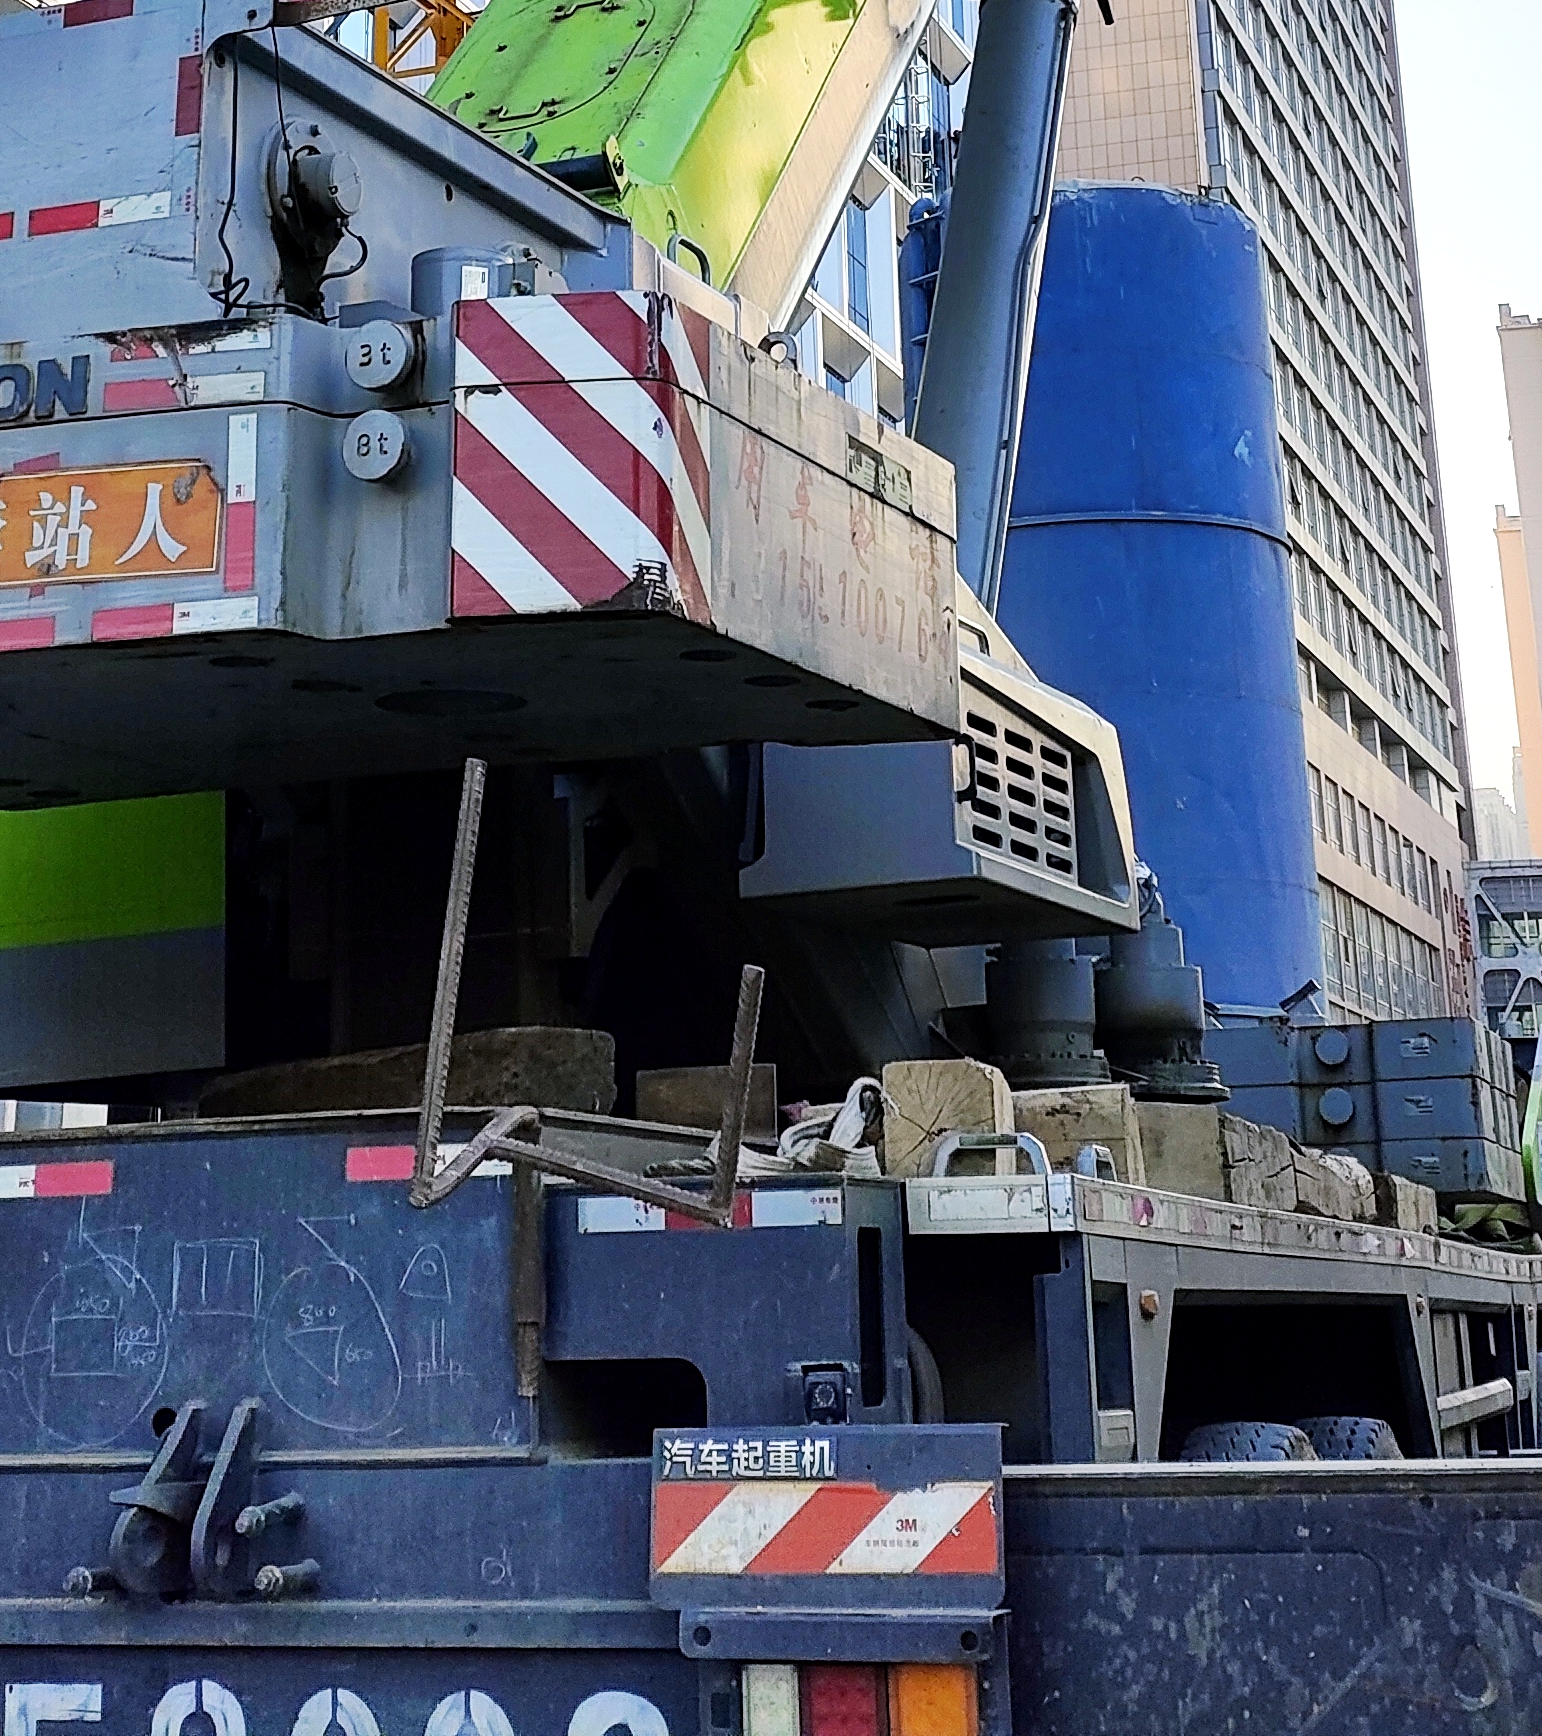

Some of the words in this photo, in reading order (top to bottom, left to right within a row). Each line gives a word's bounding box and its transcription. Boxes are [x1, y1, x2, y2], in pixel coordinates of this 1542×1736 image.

[662, 1438, 835, 1478] 汽车起重机
[895, 1518, 917, 1533] 3M
